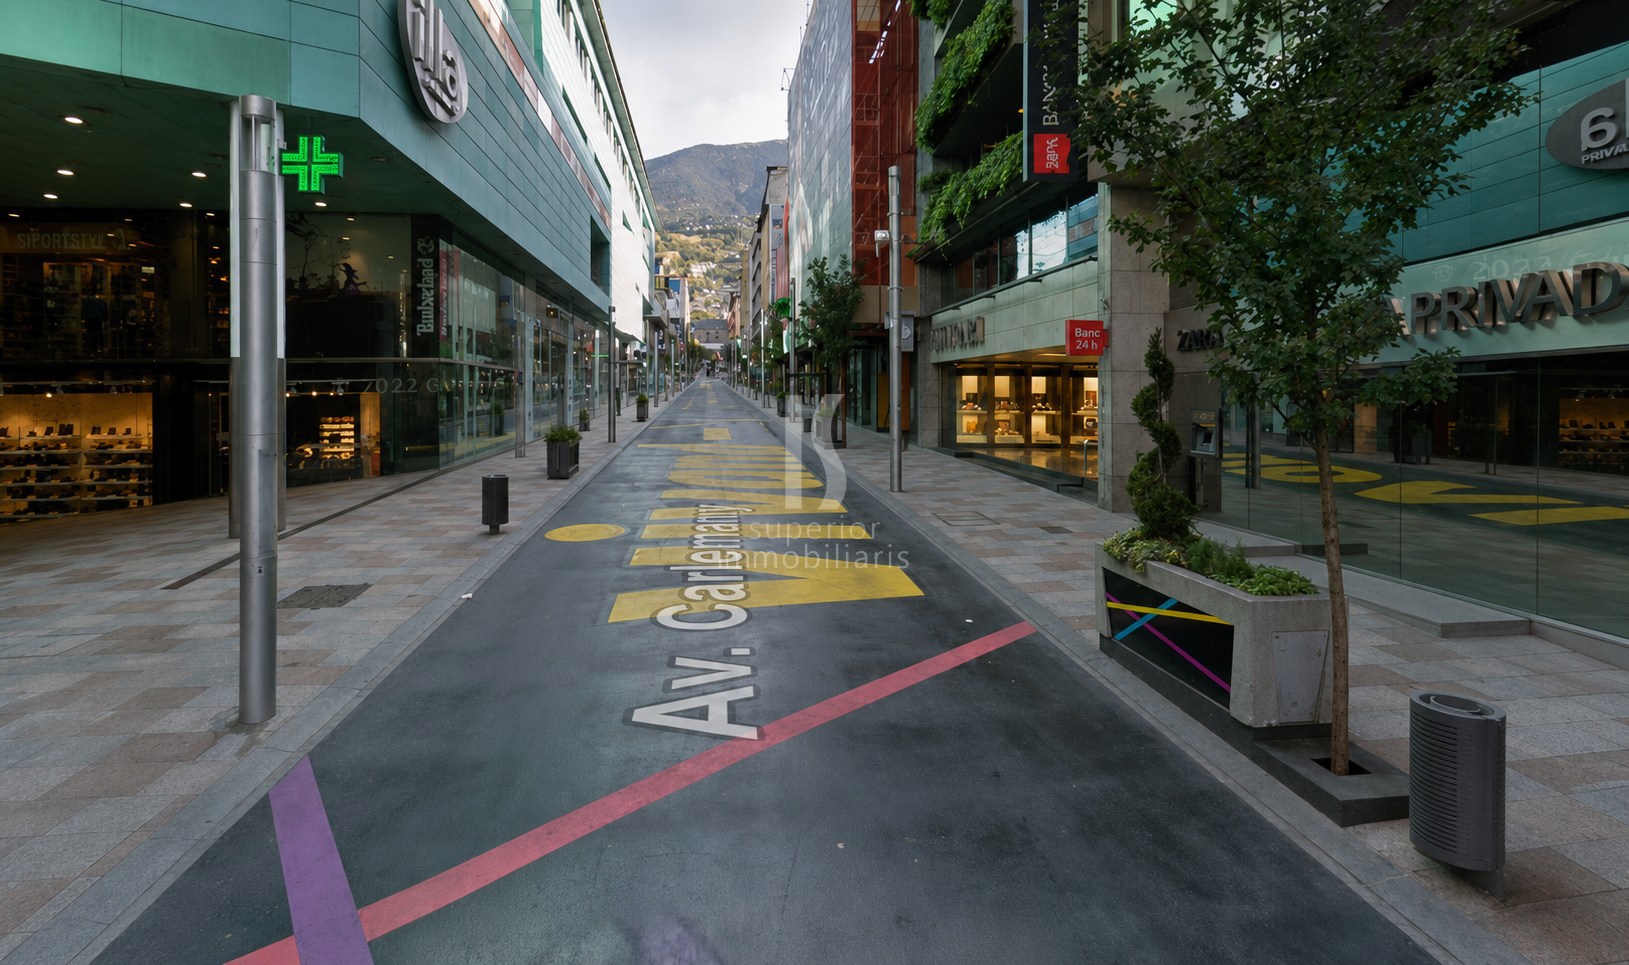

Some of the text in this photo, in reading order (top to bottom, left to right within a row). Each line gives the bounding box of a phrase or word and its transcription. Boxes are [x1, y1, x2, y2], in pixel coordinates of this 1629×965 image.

[1074, 327, 1100, 338] Banc
[1075, 339, 1098, 350] 24 h
[631, 646, 759, 741] Av.
